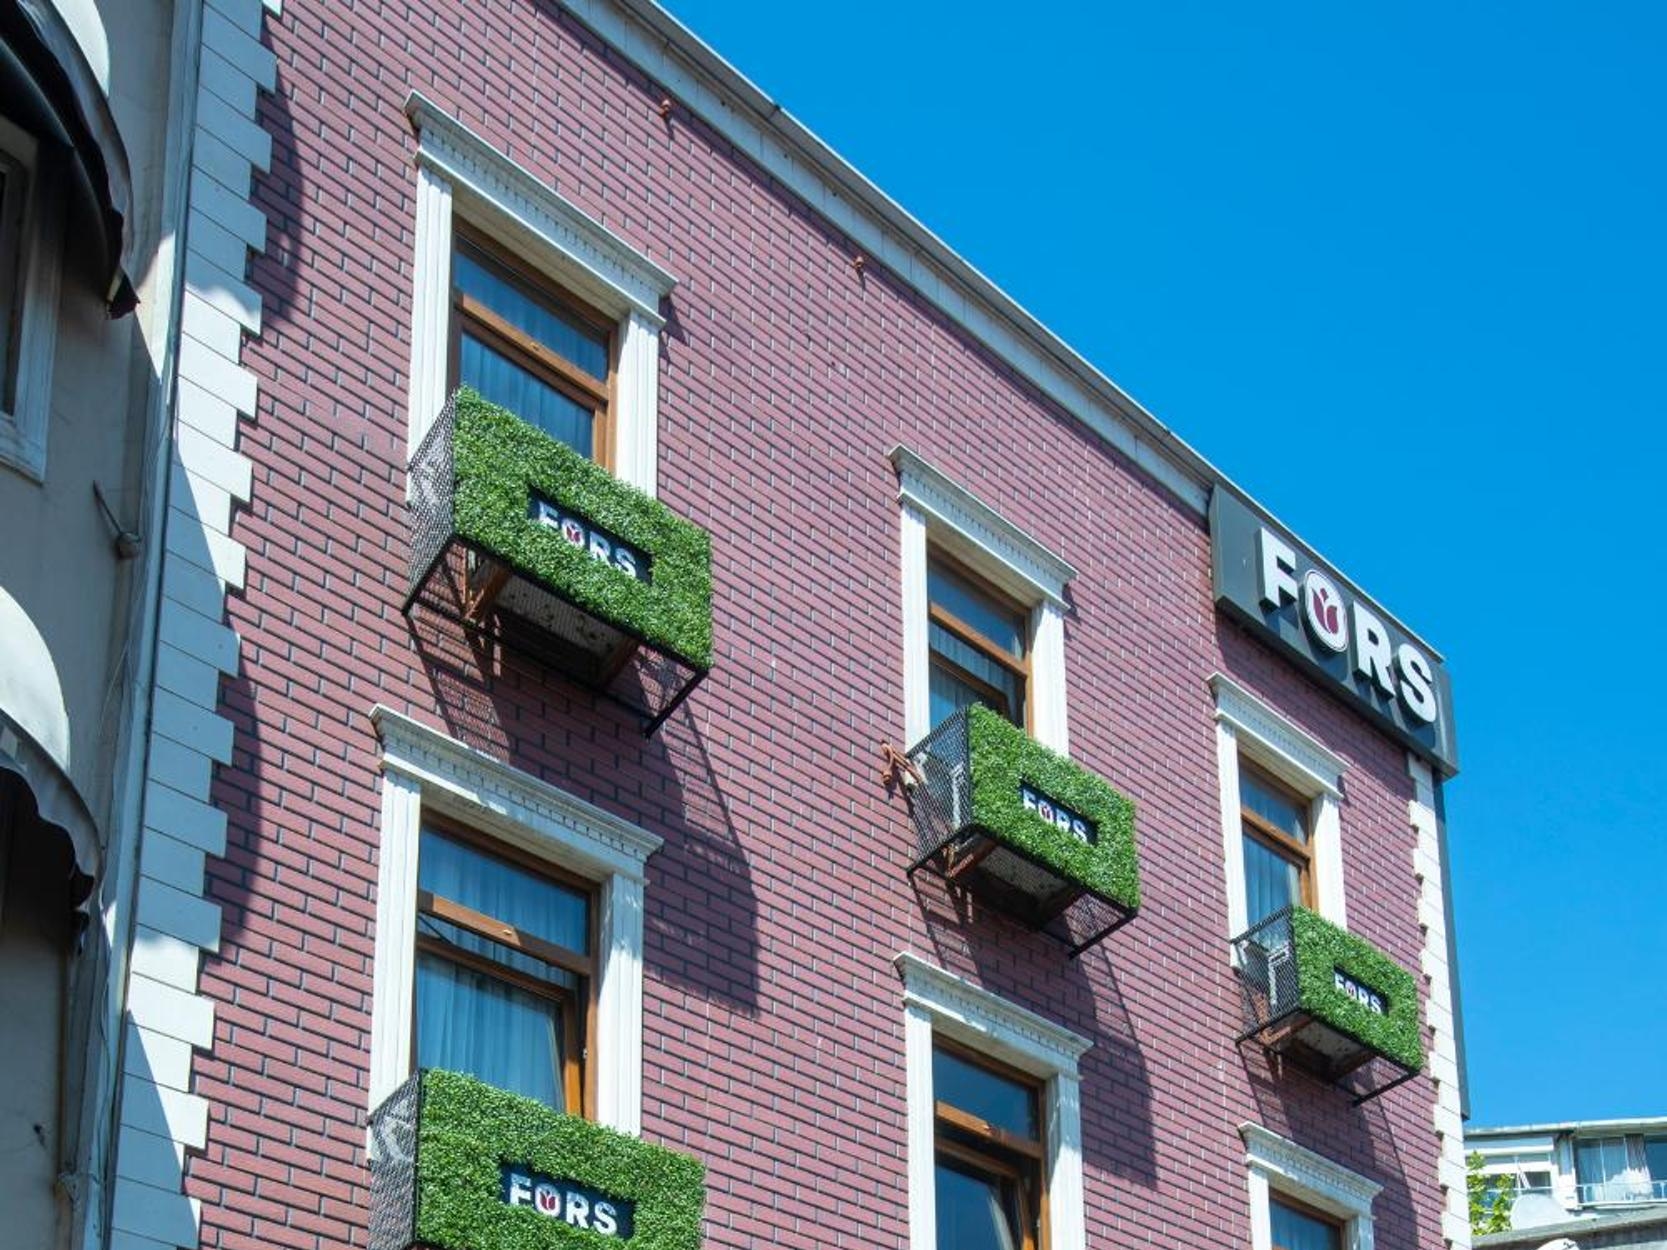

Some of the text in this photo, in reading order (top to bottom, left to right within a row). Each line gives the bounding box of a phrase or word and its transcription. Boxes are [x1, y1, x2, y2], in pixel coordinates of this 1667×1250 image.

[538, 501, 637, 578] FORS
[1260, 527, 1437, 723] FORS
[1023, 788, 1088, 842] FORS
[1334, 972, 1382, 1015] FORS
[510, 1172, 617, 1236] FORS
